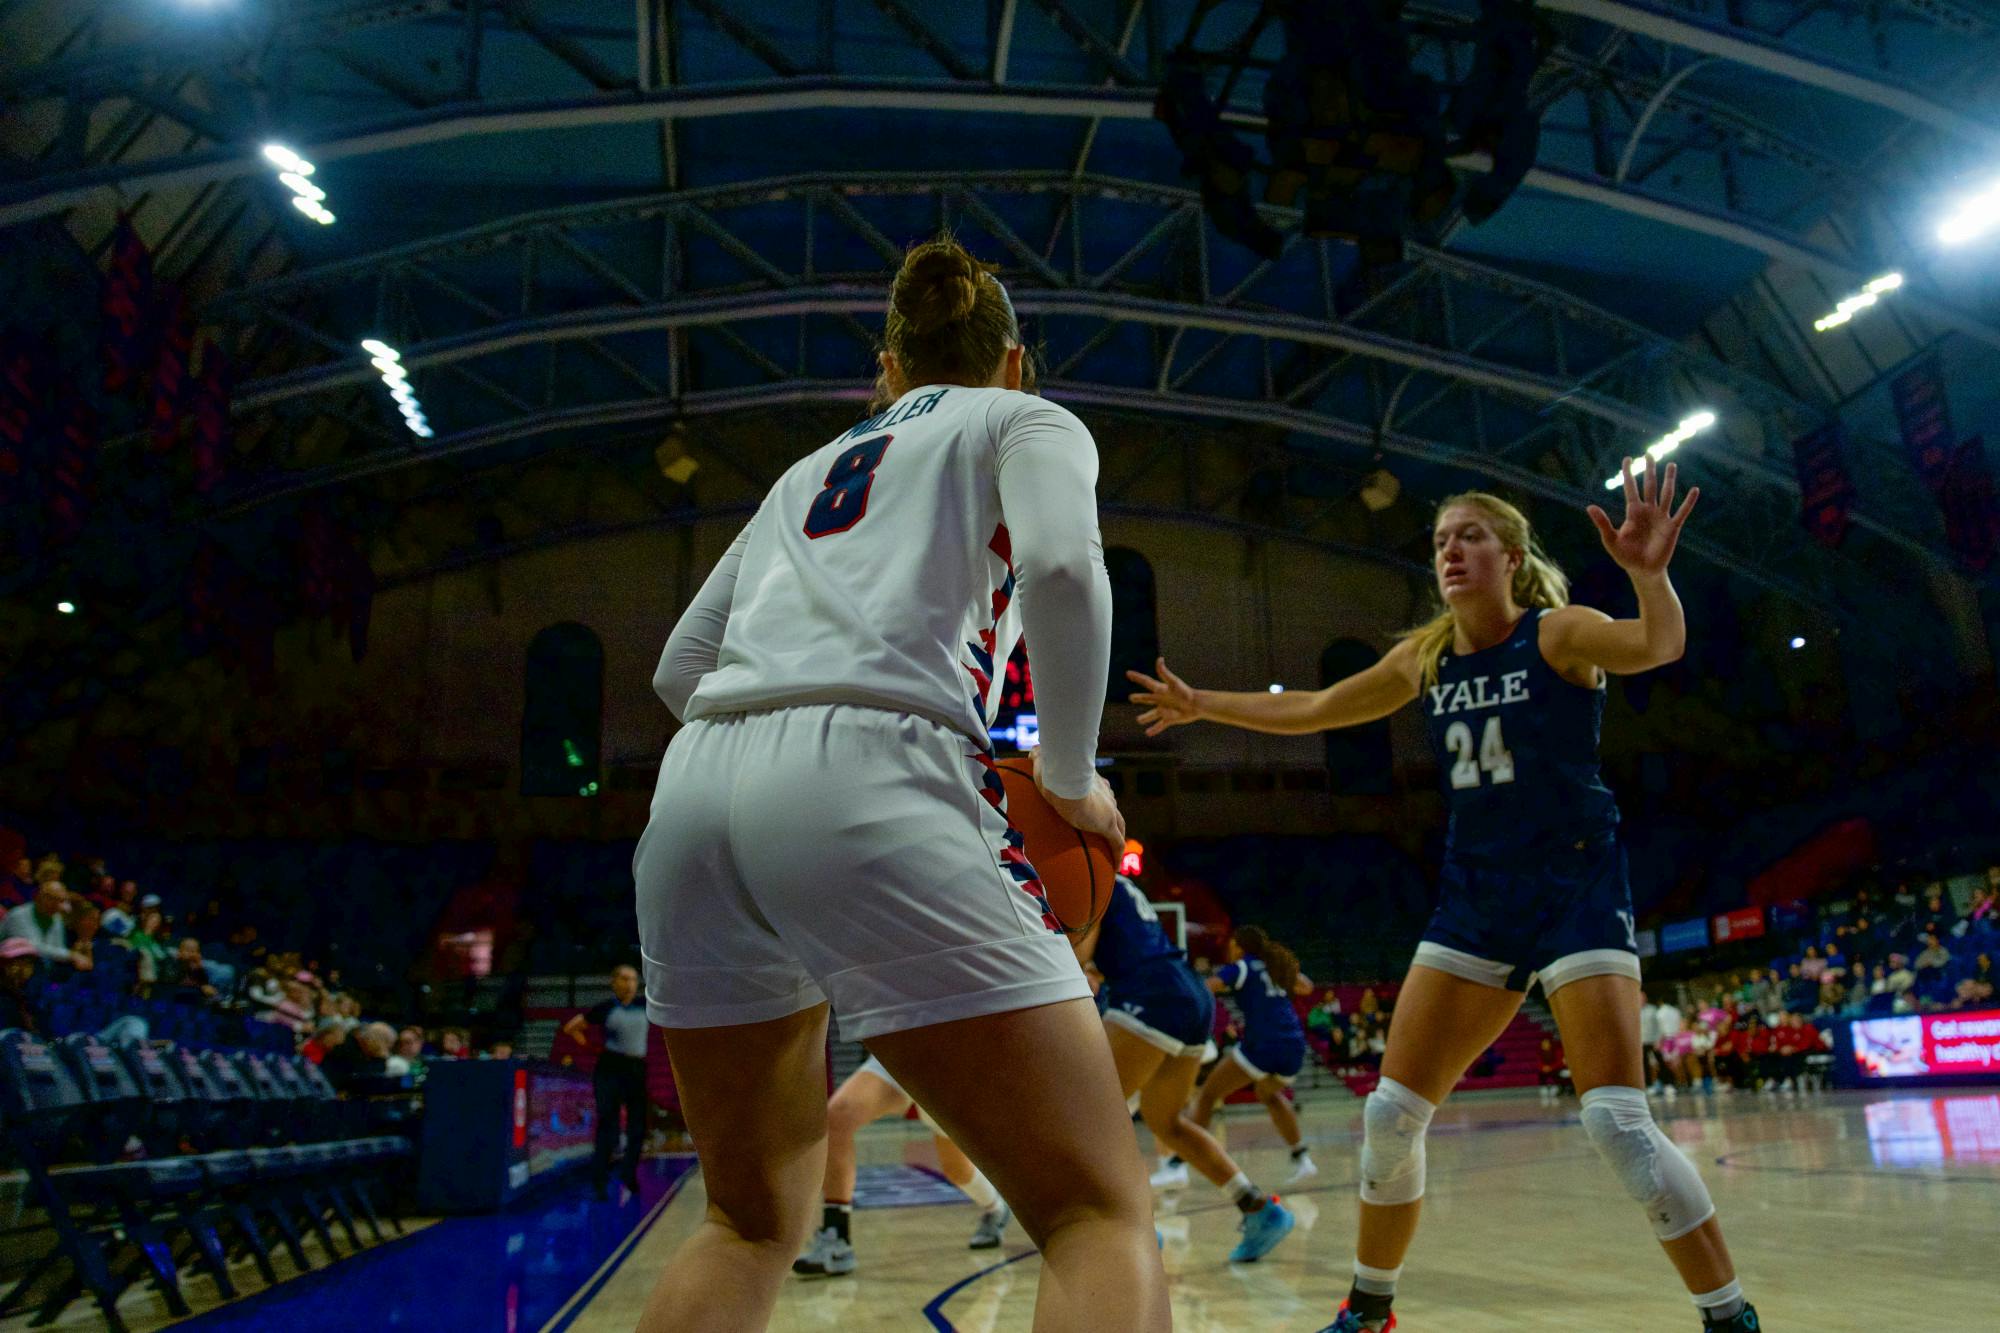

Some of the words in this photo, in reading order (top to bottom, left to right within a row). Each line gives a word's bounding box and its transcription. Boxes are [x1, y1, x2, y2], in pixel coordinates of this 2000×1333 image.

[802, 433, 894, 540] 8
[1429, 669, 1531, 716] YALE
[1445, 716, 1516, 790] 24
[1615, 909, 1638, 949] Y
